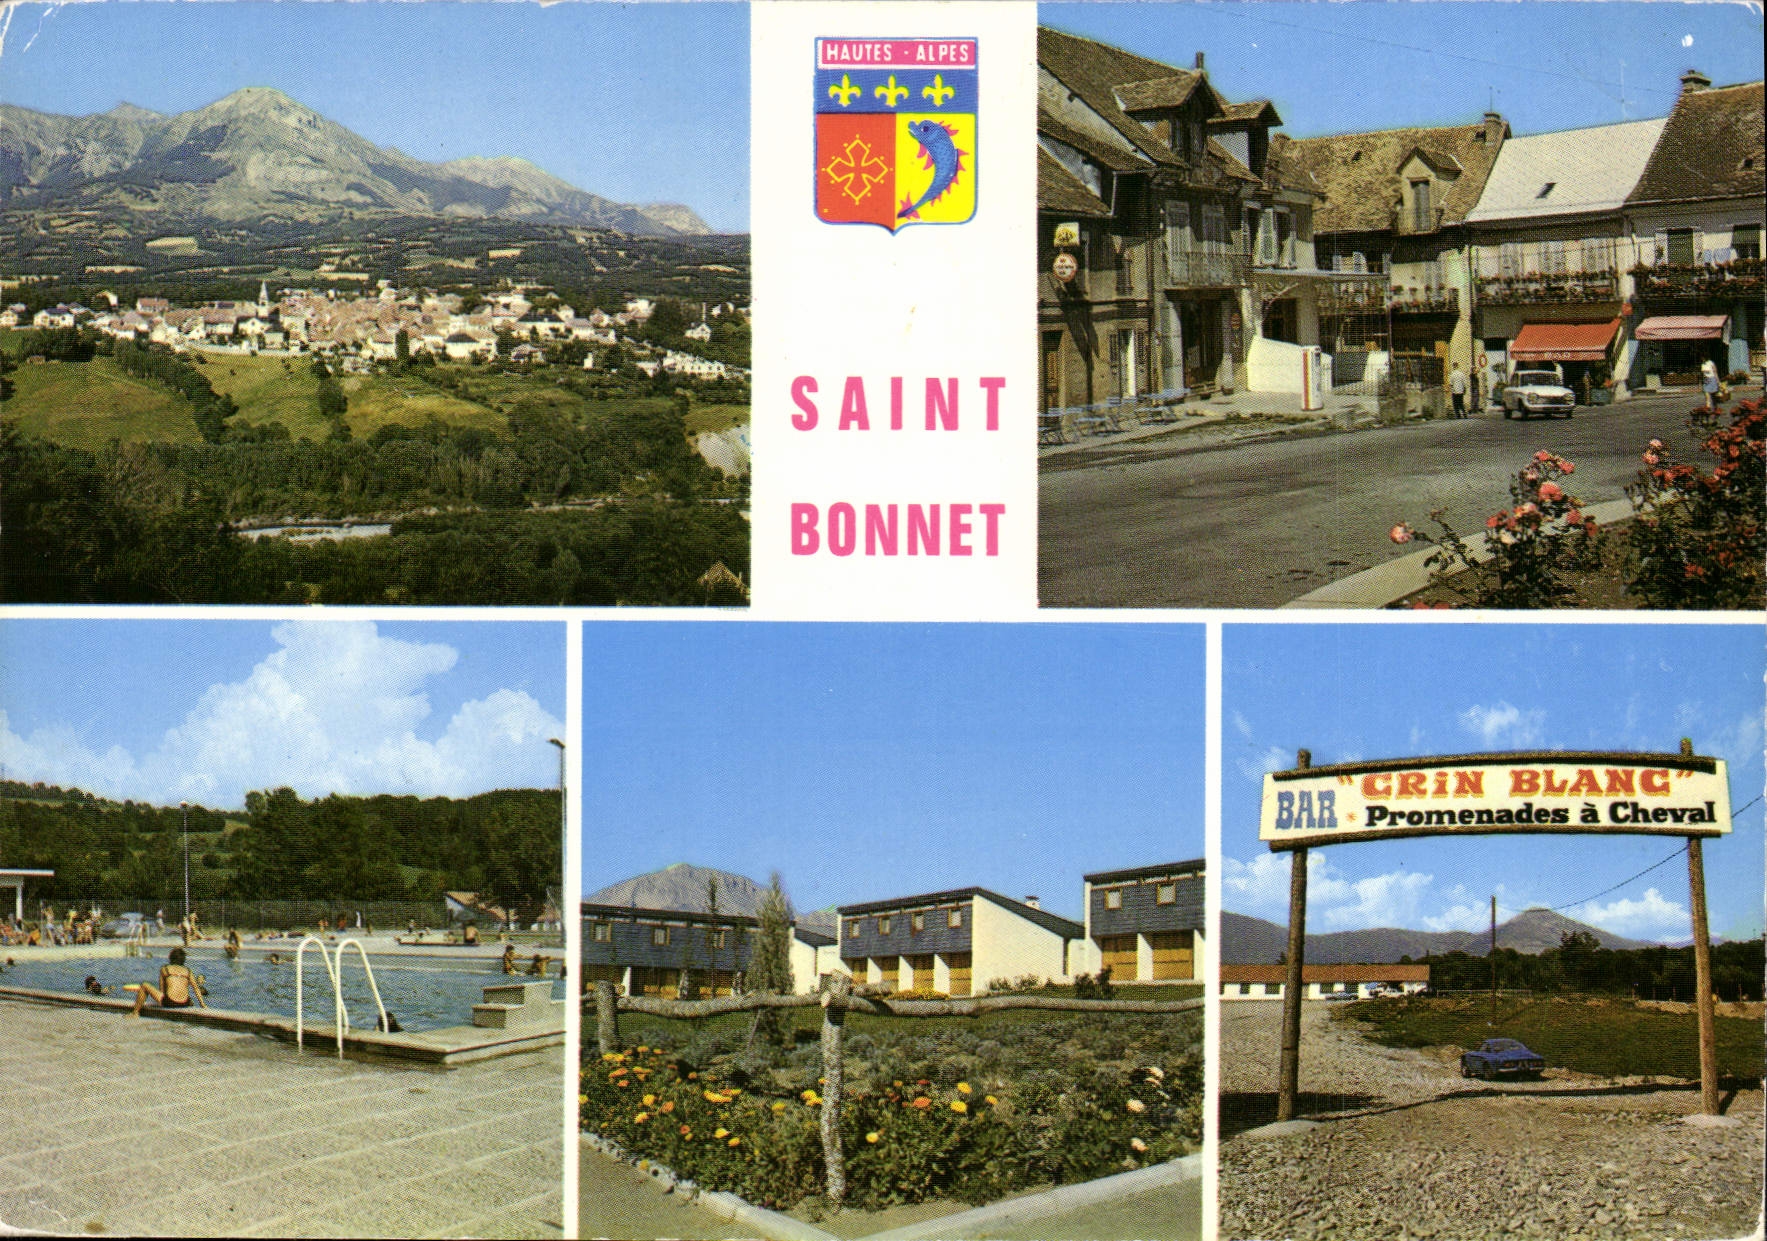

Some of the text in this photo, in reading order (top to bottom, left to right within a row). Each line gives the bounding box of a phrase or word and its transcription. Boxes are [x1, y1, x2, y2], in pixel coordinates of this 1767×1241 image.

[826, 44, 892, 62] HAUTES
[916, 44, 970, 62] ALPES
[790, 375, 1006, 431] SAINT
[790, 502, 1006, 557] BONNET
[1275, 790, 1338, 830] BAR
[1365, 801, 1717, 826] Promenades à Cheval
